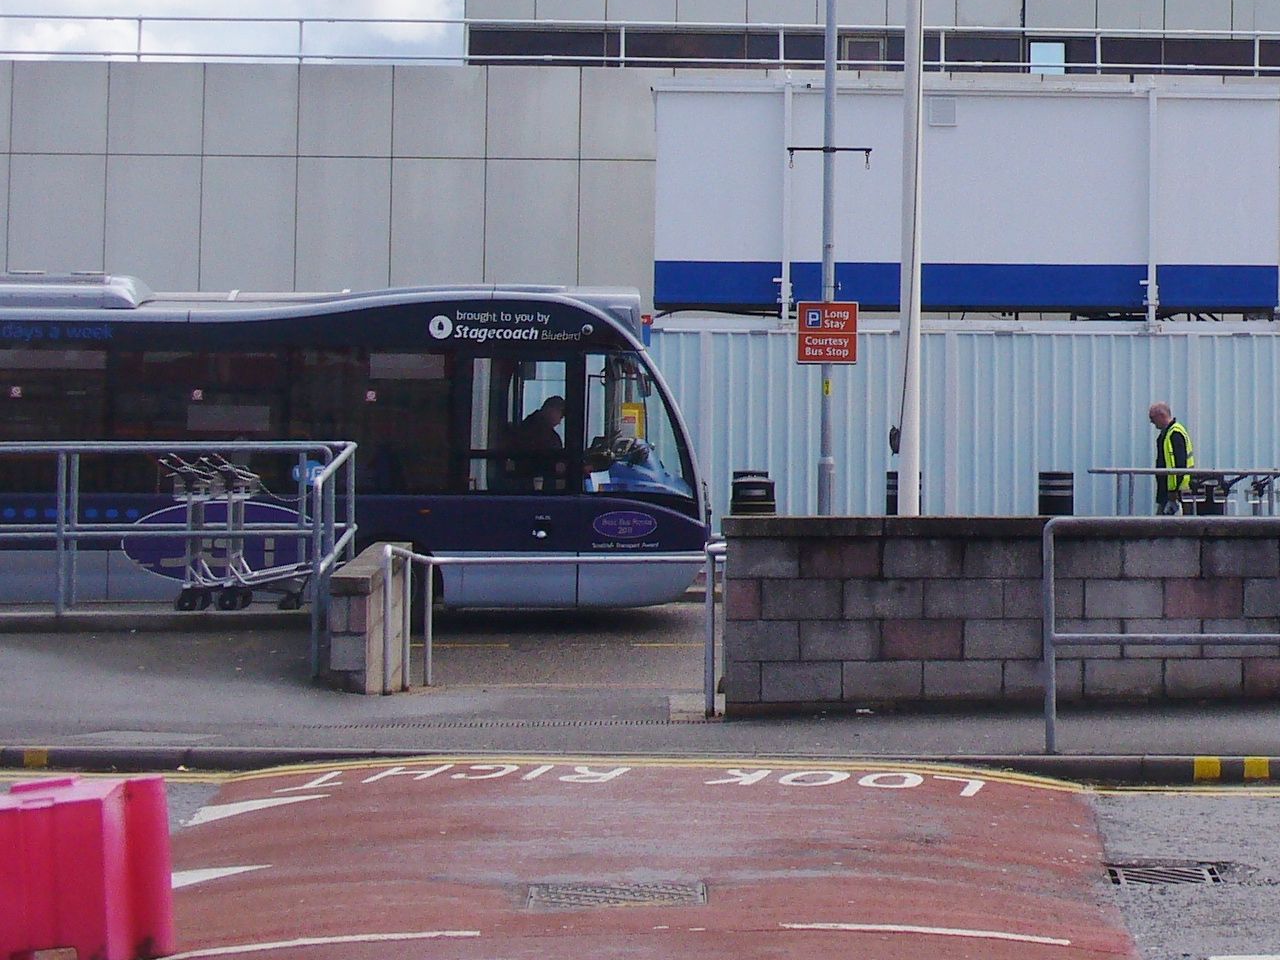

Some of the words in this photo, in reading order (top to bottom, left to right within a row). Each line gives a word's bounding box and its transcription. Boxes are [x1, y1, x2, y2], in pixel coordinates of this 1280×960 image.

[456, 310, 497, 323] brought
[500, 312, 512, 321] to
[514, 313, 534, 324] you
[537, 312, 550, 324] by
[808, 312, 820, 326] P
[824, 310, 850, 321] Long
[824, 319, 847, 330] Stay
[454, 324, 538, 342] Stagecoach
[541, 330, 581, 341] Bluebird
[805, 336, 850, 348] Courtesy
[805, 347, 824, 356] Bus
[825, 347, 849, 358] Stop
[273, 764, 632, 792] RIGHT
[704, 769, 986, 797] LOOK
